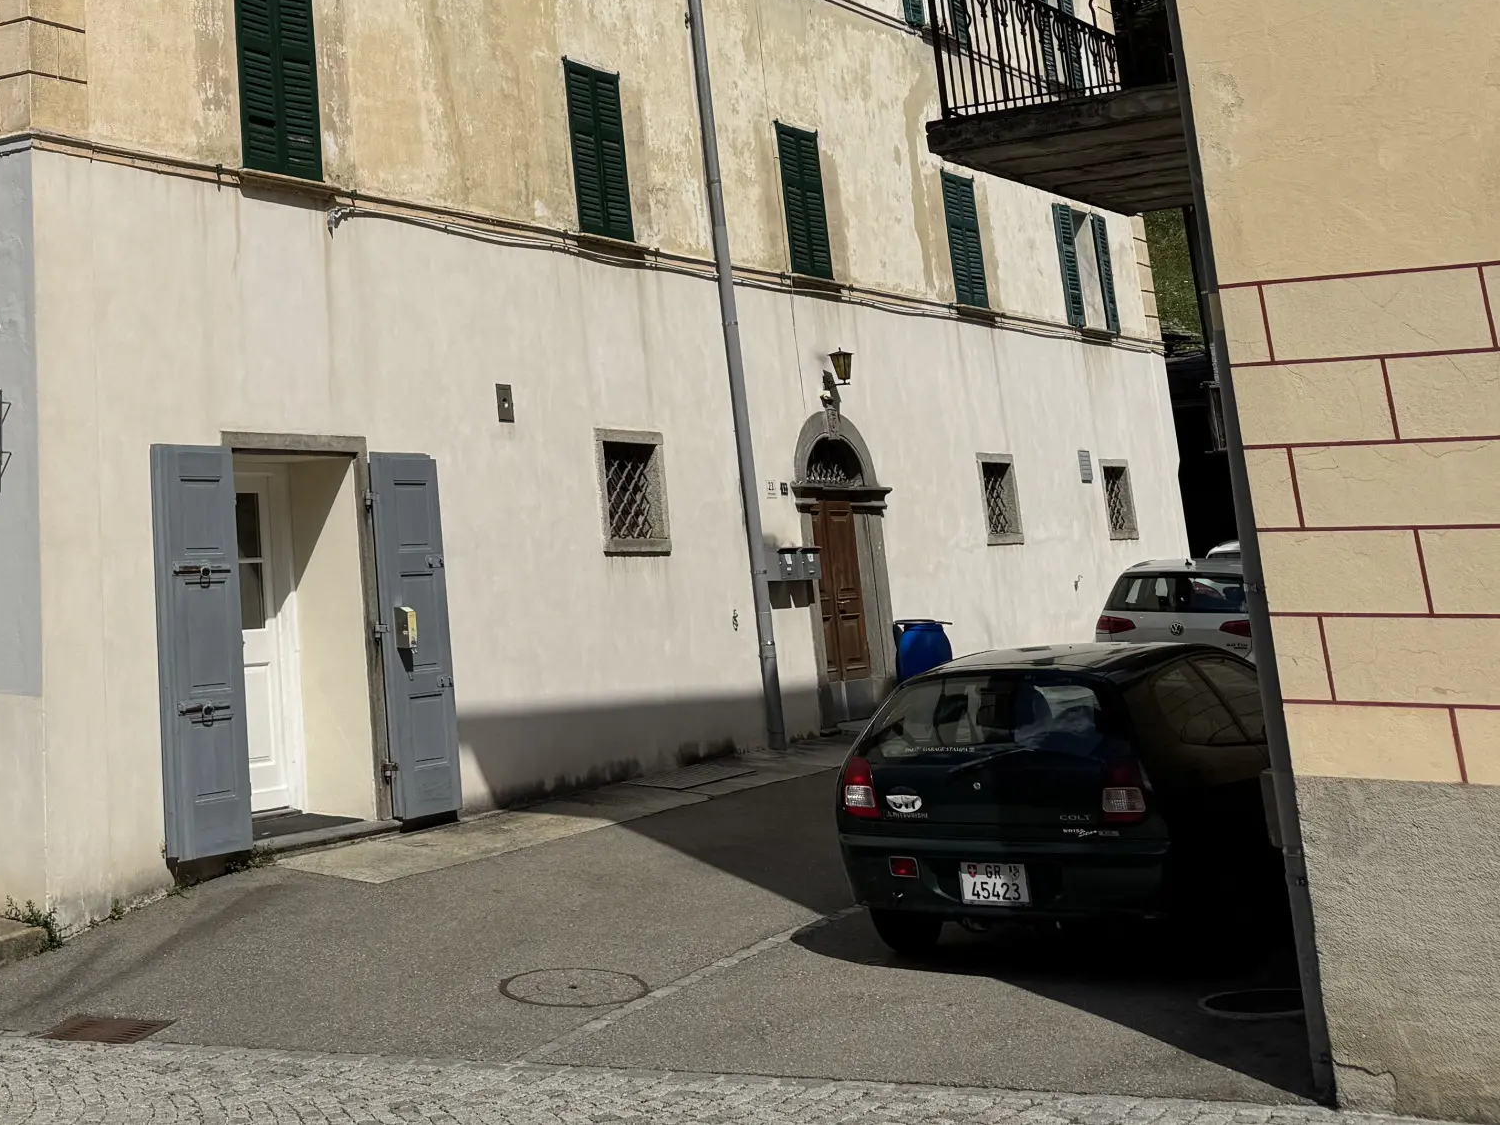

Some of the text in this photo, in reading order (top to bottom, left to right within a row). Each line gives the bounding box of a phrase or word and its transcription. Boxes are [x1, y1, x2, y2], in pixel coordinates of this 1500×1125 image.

[1059, 813, 1091, 821] COLT
[985, 864, 1002, 880] GR
[972, 881, 1021, 901] 45423
